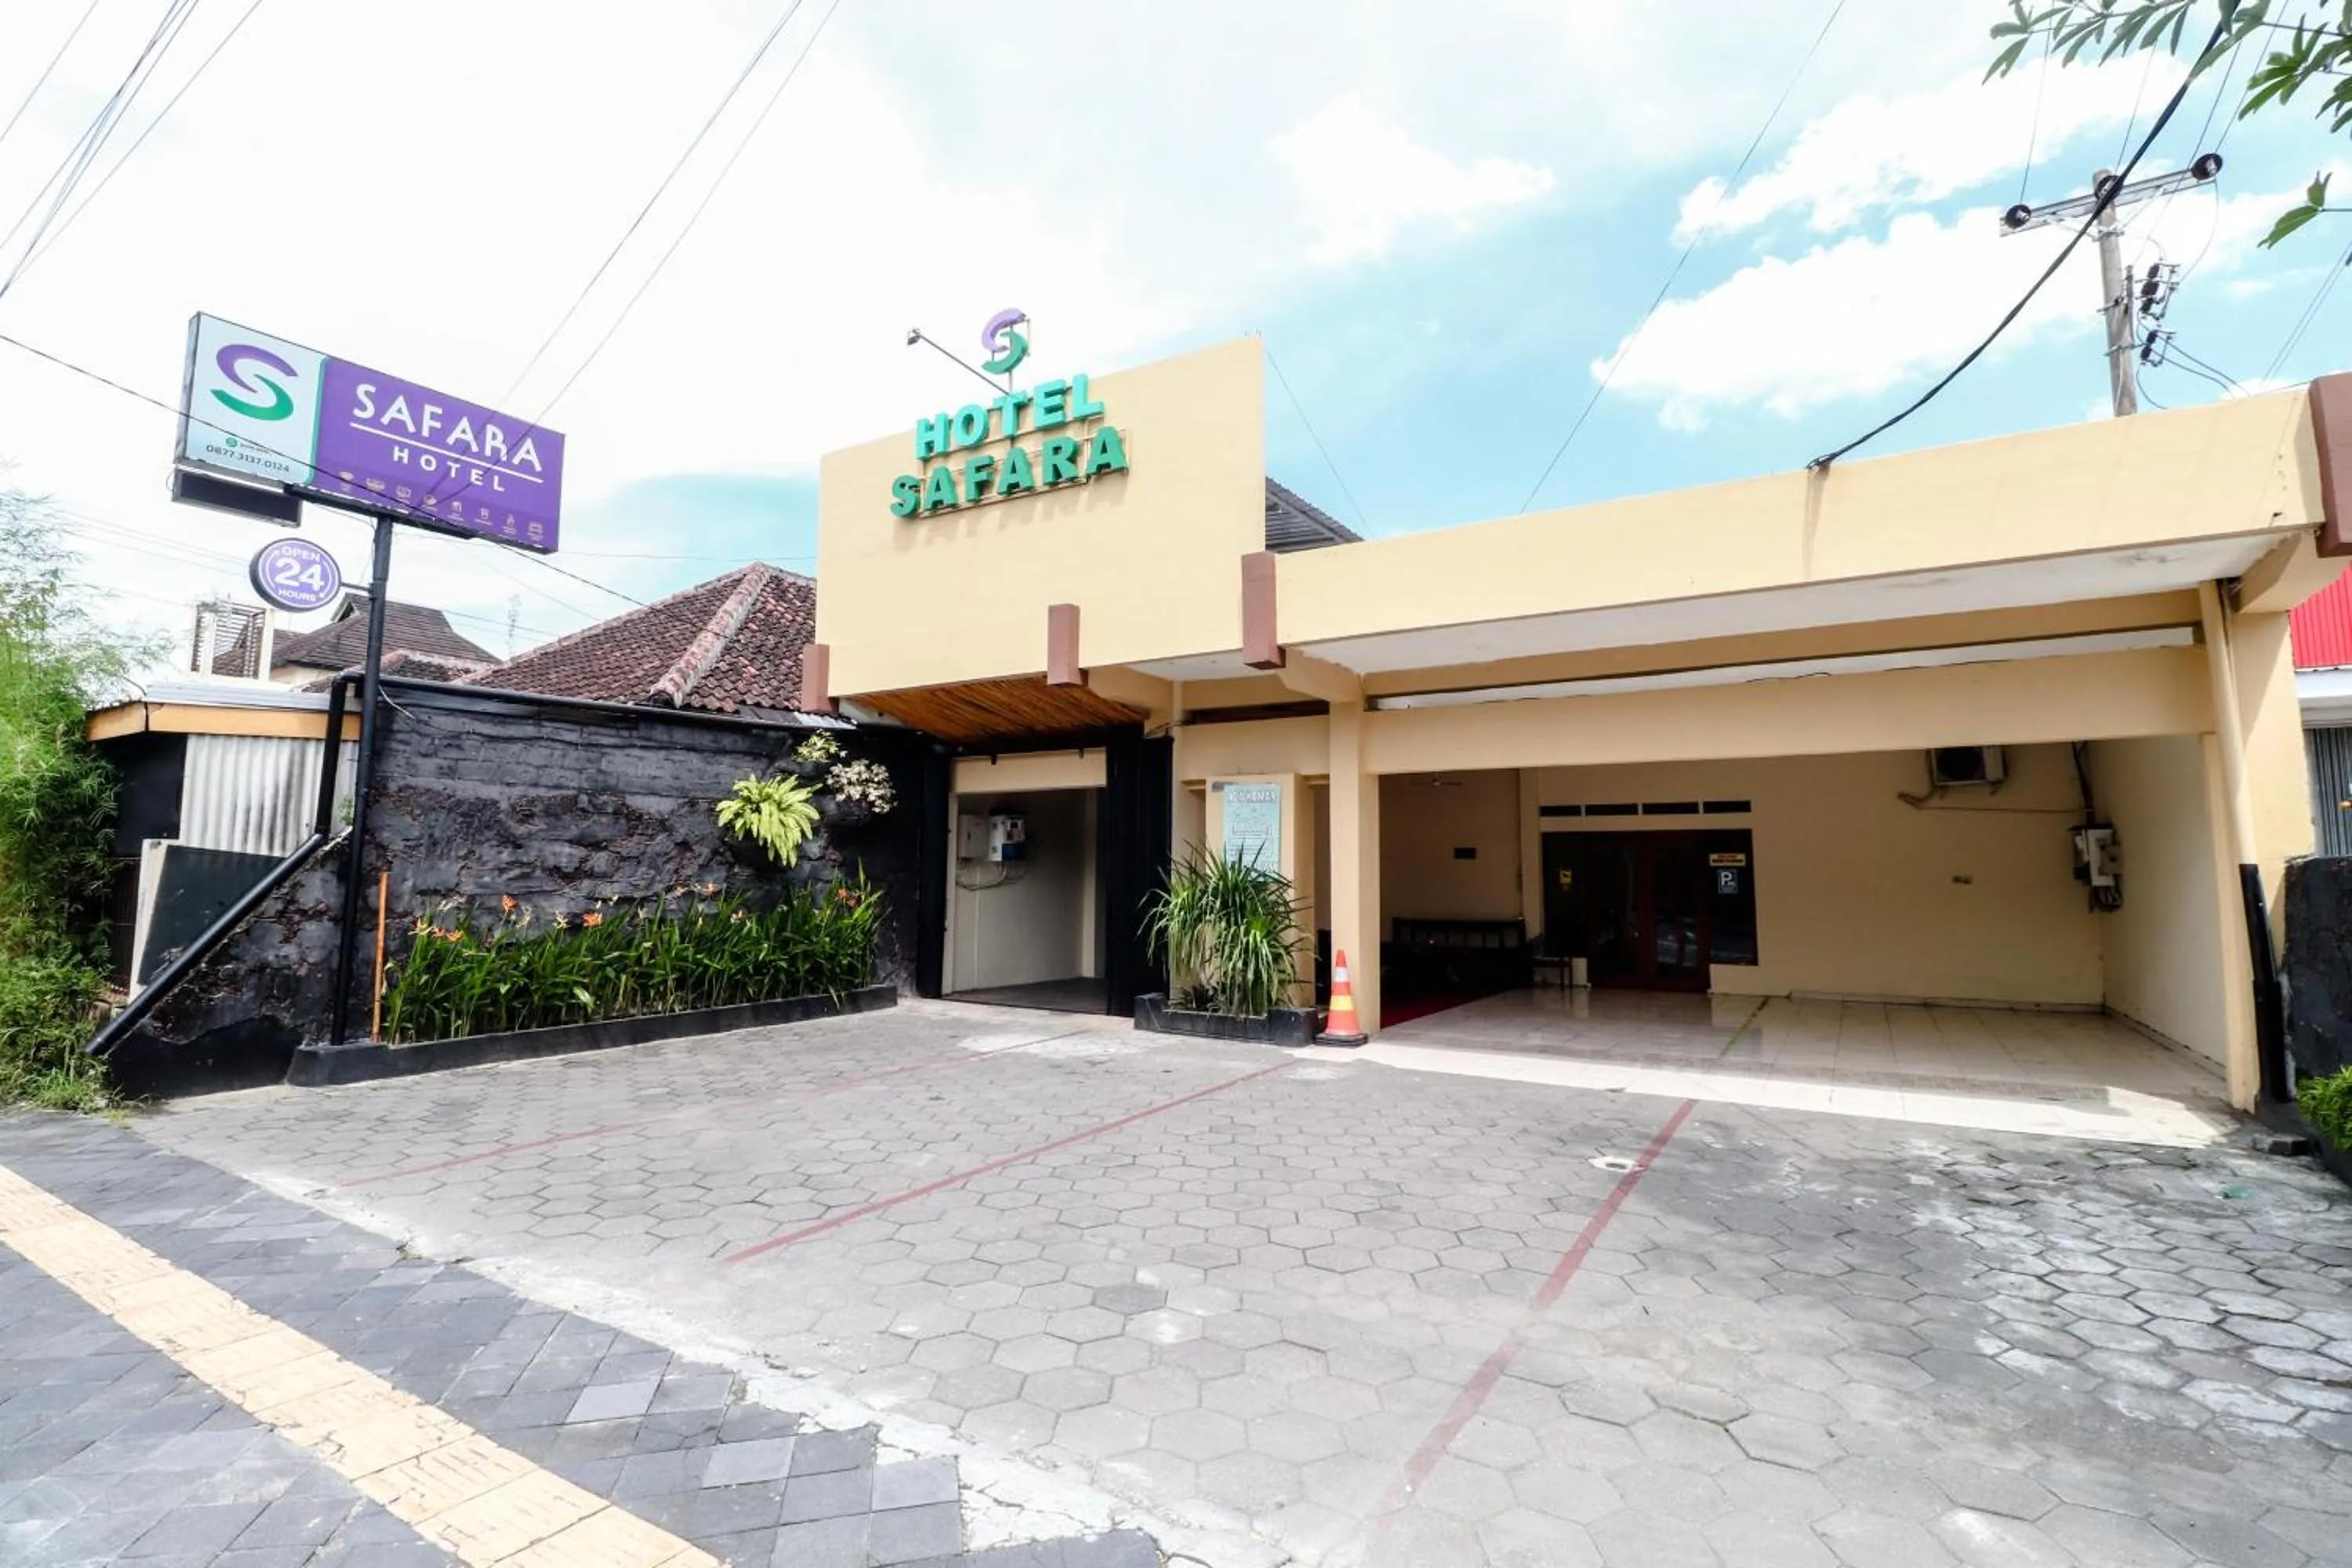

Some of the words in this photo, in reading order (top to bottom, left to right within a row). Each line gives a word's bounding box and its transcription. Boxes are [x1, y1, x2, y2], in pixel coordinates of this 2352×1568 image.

[210, 344, 298, 420] S
[353, 383, 543, 472] SAFARA
[916, 374, 1105, 461] HOTEL
[393, 445, 505, 492] HOTEL
[891, 426, 1129, 517] SAFARA
[274, 557, 325, 591] 24
[281, 546, 321, 563] OPEN
[278, 589, 316, 602] HOURS
